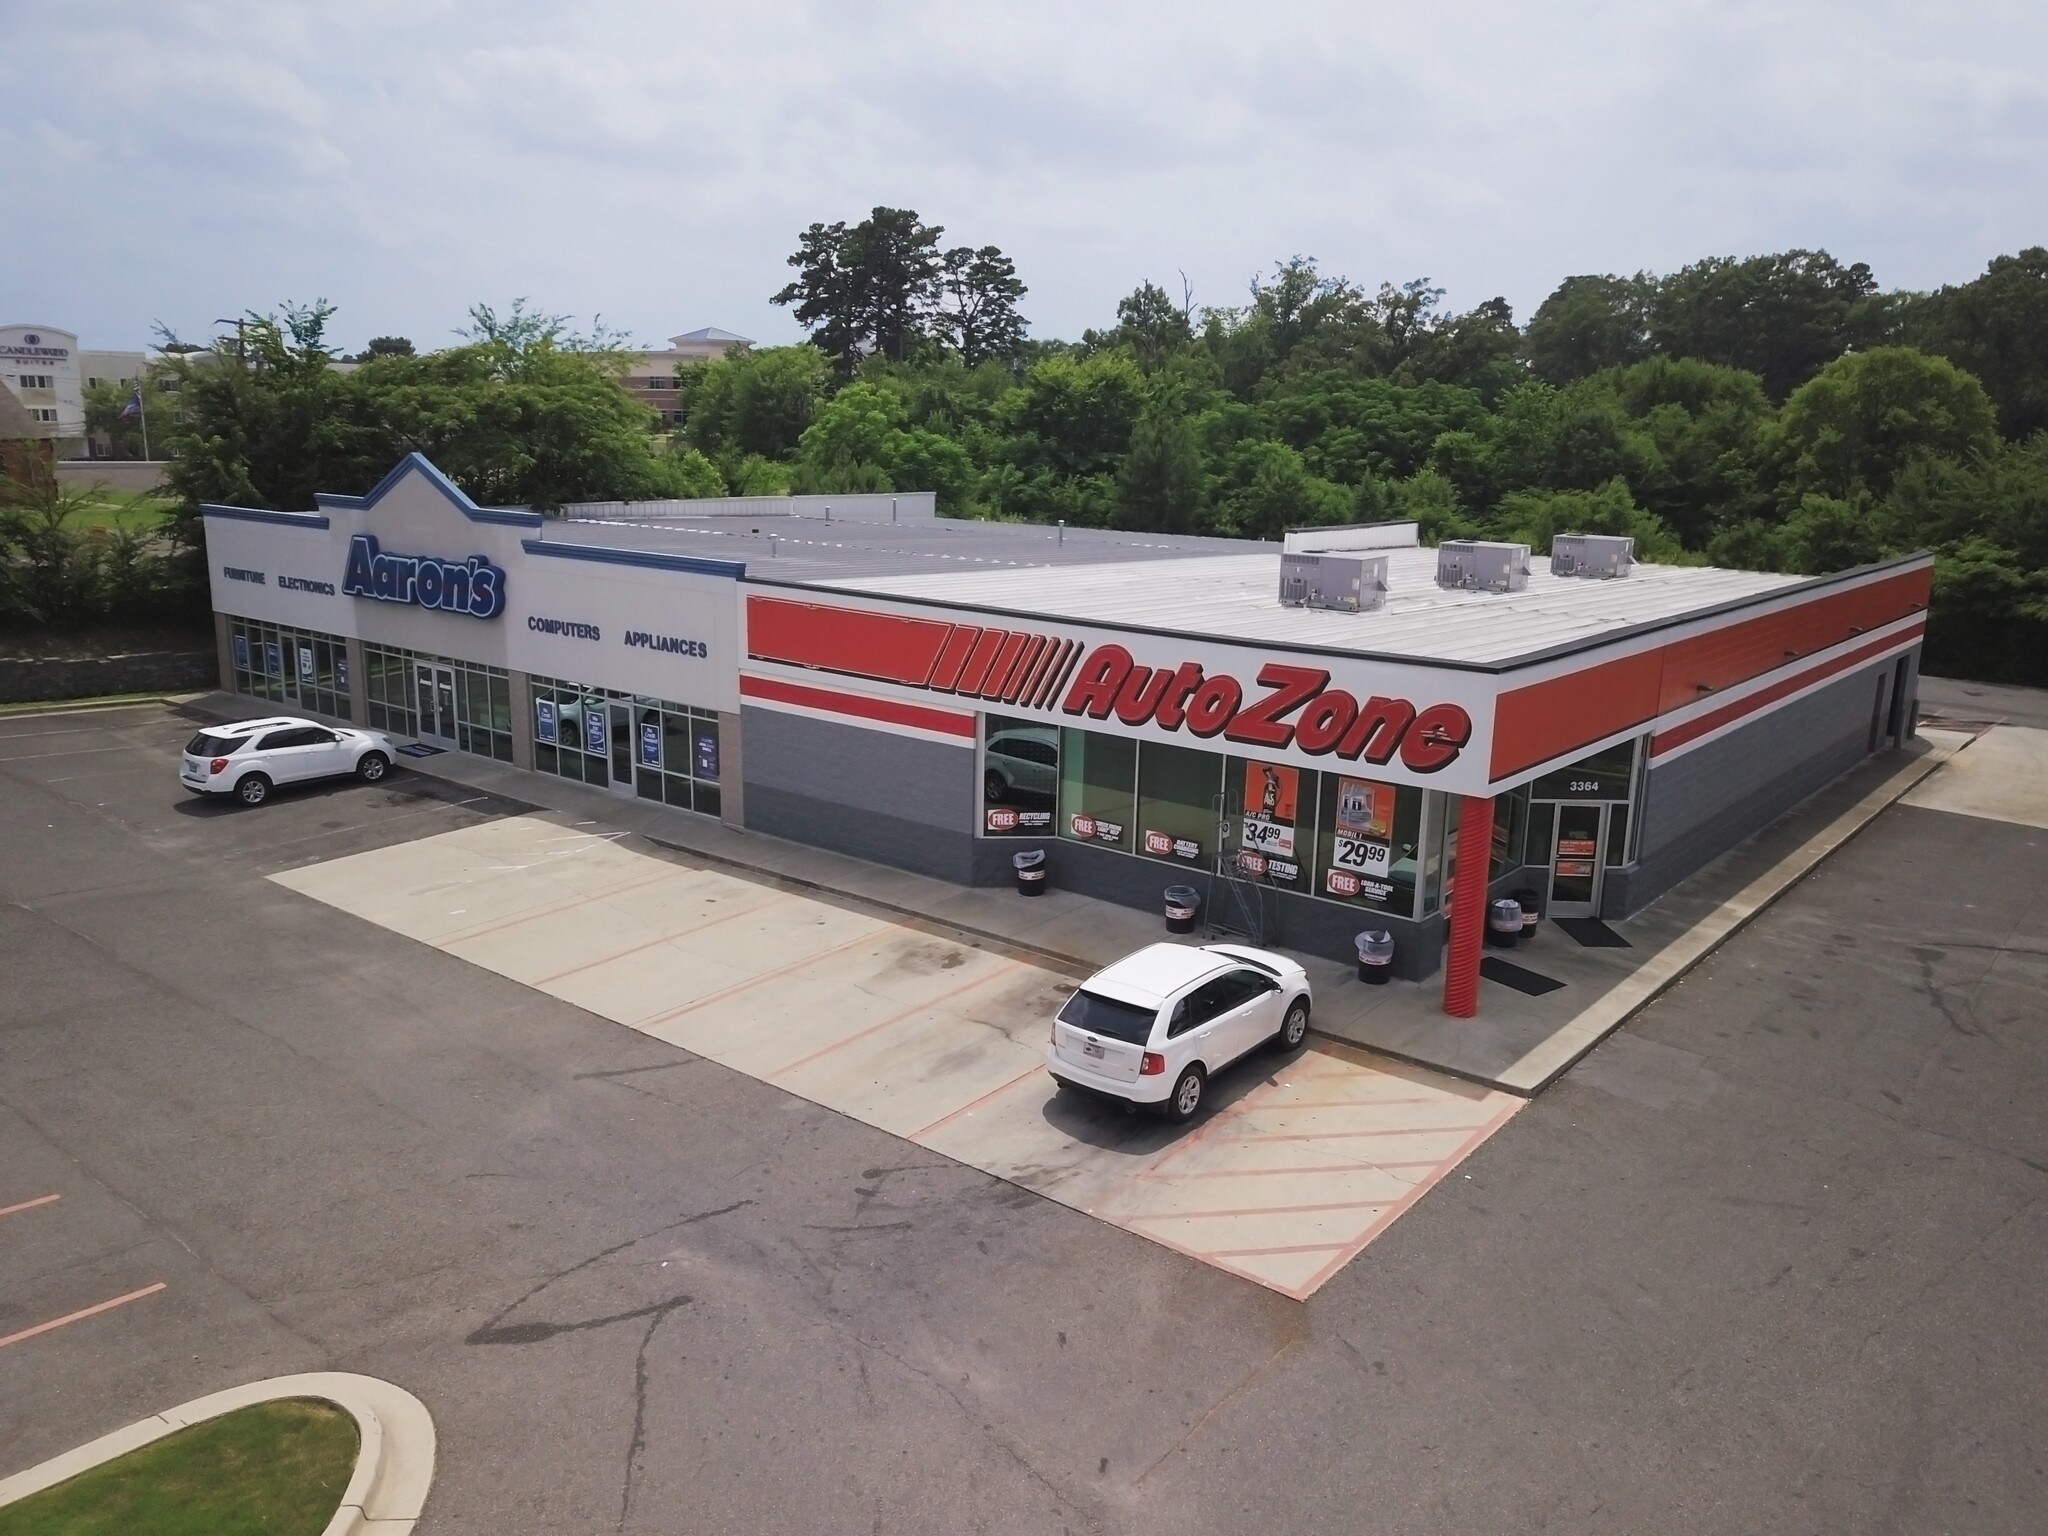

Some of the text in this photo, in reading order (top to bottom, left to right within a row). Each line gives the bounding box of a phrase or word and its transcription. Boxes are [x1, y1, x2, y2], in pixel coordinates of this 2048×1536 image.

[0, 345, 68, 357] CANDLEWOOD
[223, 566, 335, 596] FURNITURE ELECTRONICS
[343, 535, 506, 619] Aaron's
[528, 616, 707, 659] COMPUTERS APPLIANCES
[1062, 644, 1472, 774] AutoZone
[1569, 781, 1599, 791] 3364
[992, 813, 1014, 826] FREE
[1245, 810, 1257, 818] A/C
[1257, 813, 1270, 821] PRO
[1074, 819, 1093, 834] FREE
[1337, 829, 1357, 838] MOBIL
[1149, 835, 1169, 851] FREE
[1242, 855, 1263, 872] FREE
[1268, 859, 1299, 875] TESTING
[1331, 874, 1355, 893] FREE
